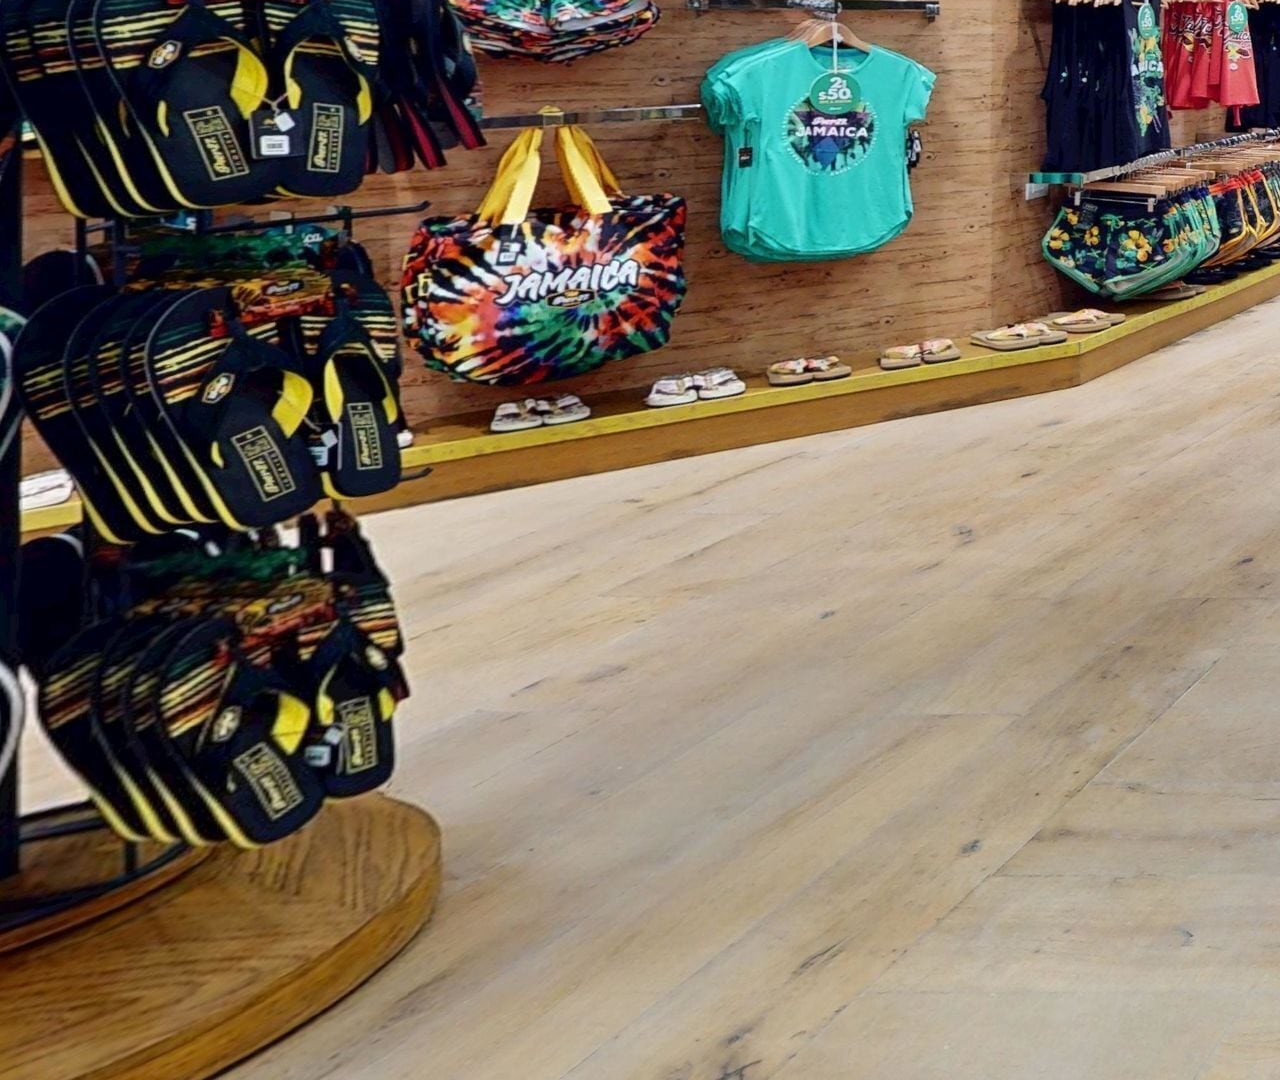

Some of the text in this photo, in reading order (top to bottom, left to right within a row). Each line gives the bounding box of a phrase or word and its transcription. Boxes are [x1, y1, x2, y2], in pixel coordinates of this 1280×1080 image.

[818, 88, 852, 100] $50
[795, 126, 868, 137] JAMAICA
[495, 260, 639, 306] JAMAICA
